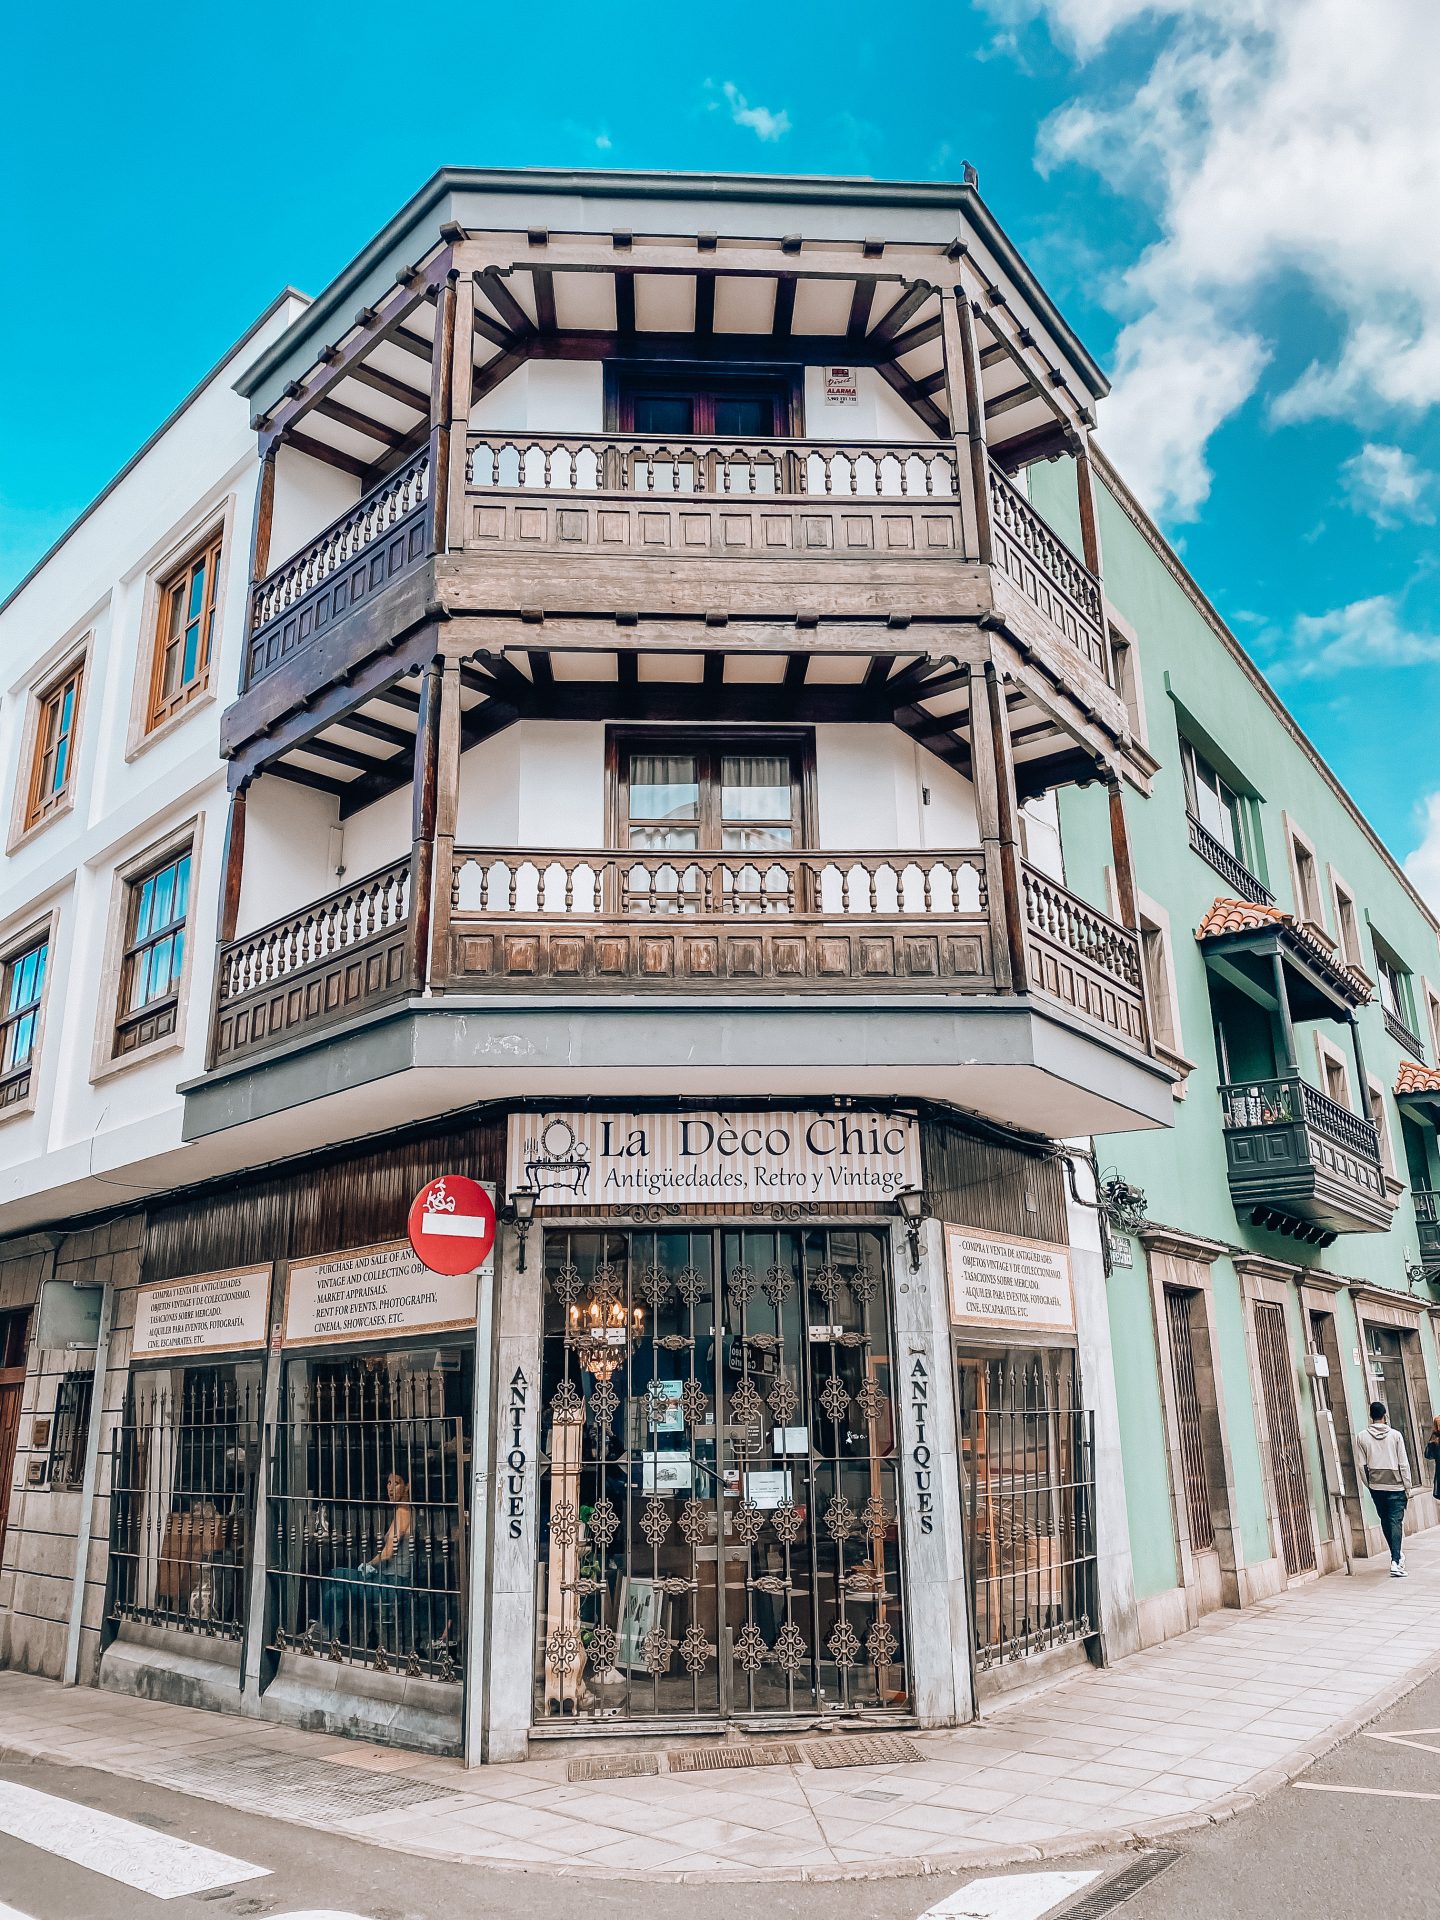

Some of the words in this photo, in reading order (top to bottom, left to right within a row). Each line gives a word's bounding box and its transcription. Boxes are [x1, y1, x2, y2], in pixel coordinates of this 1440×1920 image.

[600, 1121, 650, 1157] La
[679, 1118, 789, 1156] Dèco
[805, 1118, 906, 1155] Chic
[605, 1164, 748, 1195] Antigüedades,
[755, 1166, 806, 1186] Retro
[811, 1172, 822, 1192] y
[827, 1165, 903, 1194] Vintage
[962, 1241, 986, 1253] COMPRA
[989, 1246, 1007, 1256] VENTA
[1008, 1249, 1014, 1258] DE
[319, 1261, 353, 1274] PURCHASE
[355, 1258, 369, 1268] AND
[371, 1256, 387, 1265] SALE
[389, 1253, 399, 1262] OF
[963, 1256, 986, 1268] OBJETOS
[986, 1260, 1008, 1271] VINTAGE
[1014, 1264, 1020, 1273] DE
[317, 1277, 345, 1289] VINTAGE
[347, 1274, 362, 1285] AND
[363, 1266, 409, 1282] COLLECTING
[964, 1271, 996, 1284] TASACIONES
[996, 1276, 1013, 1286] SOBRE
[176, 1287, 192, 1296] VENTA
[192, 1285, 200, 1293] DE
[200, 1278, 241, 1292] ANTIGÜEDADES
[317, 1291, 345, 1303] MARKET
[346, 1285, 387, 1299] APPRAISALS.
[965, 1287, 991, 1299] ALQUILER
[993, 1290, 1006, 1299] PARA
[150, 1302, 171, 1313] OBJETOS
[172, 1299, 192, 1309] VINTAGE
[196, 1297, 203, 1305] DE
[316, 1308, 335, 1318] RENT
[335, 1305, 349, 1316] FOR
[350, 1301, 377, 1314] EVENTS,
[380, 1292, 437, 1310] PHOTOGRAPHY,
[966, 1302, 981, 1313] CINE,
[150, 1313, 178, 1324] TASACIONES
[179, 1311, 194, 1320] SOBRE
[314, 1320, 341, 1333] CINEMA,
[343, 1314, 386, 1329] SHOWCASES,
[388, 1313, 404, 1323] ETC.
[149, 1327, 171, 1337] ALQUILER
[172, 1325, 184, 1333] PARA
[185, 1322, 208, 1332] EVENTOS,
[194, 1335, 204, 1343] ETC.
[508, 1366, 527, 1539] ANTIQUES
[911, 1359, 933, 1535] ANTIQUES
